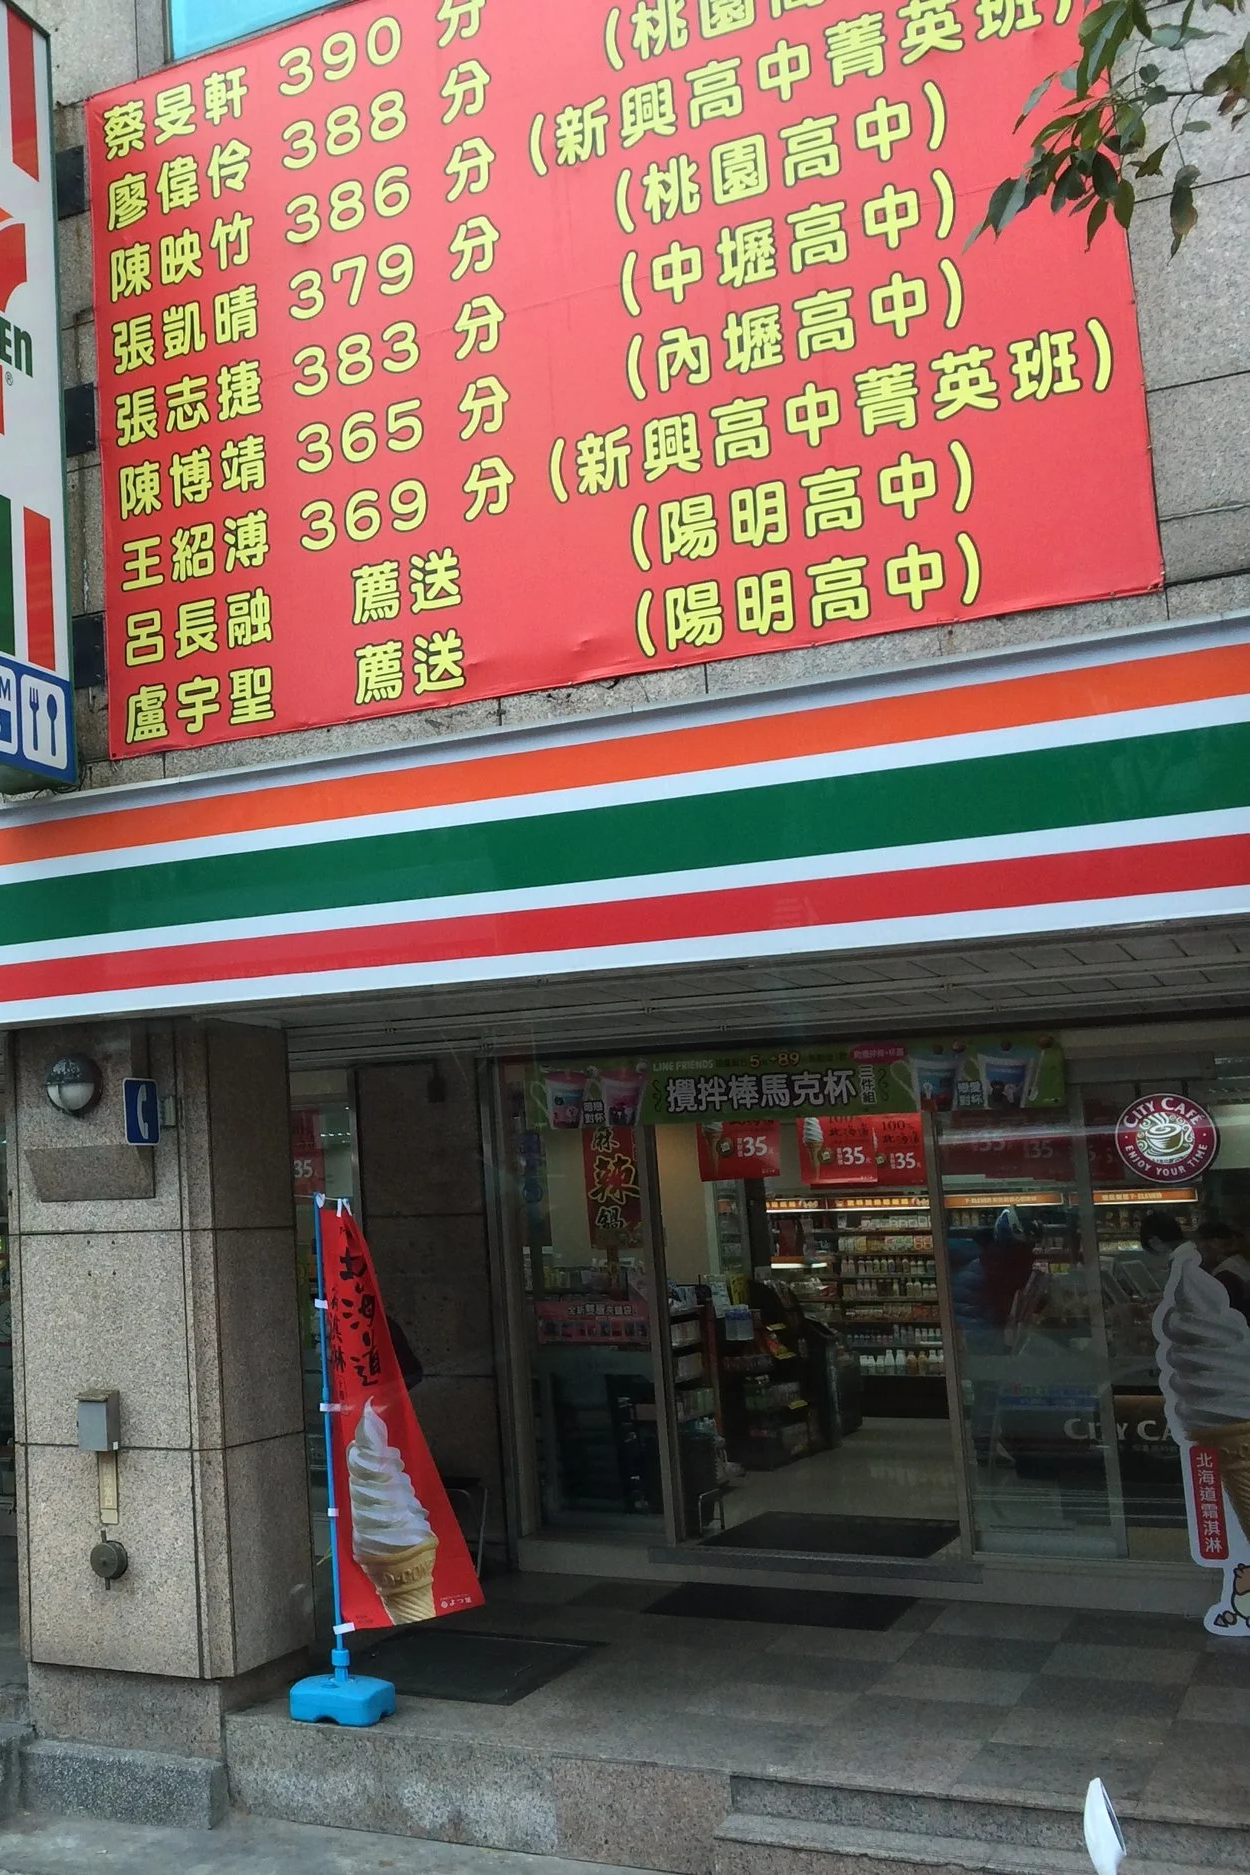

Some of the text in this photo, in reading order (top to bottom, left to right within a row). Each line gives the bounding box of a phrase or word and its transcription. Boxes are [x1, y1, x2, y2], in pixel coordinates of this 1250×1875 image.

[102, 0, 487, 160] 蔡旻軒 390 分
[107, 139, 252, 232] 廖偉伶
[282, 90, 407, 170] 388
[440, 59, 492, 126] 分
[109, 212, 254, 302] 陳映竹
[284, 165, 411, 245] 386
[445, 136, 496, 203] 分
[112, 80, 948, 375] 張凱晴 379 分 (桃園高中)
[115, 168, 956, 448] 張志捷 383 分 (中壢高中)
[119, 434, 267, 520] 陳博靖
[296, 398, 424, 474] 365
[459, 375, 510, 442] 分
[121, 317, 1113, 593] 王紹溥 369 分 (新興高中菁英班)
[125, 438, 973, 668] 呂長融 薦送 (陽明高中)
[125, 532, 982, 745] 盧宇聖 薦送 (陽明高中)
[665, 1068, 857, 1114] 攪拌棒馬克杯
[743, 1136, 768, 1157] 35
[842, 1146, 866, 1165] 35
[895, 1151, 917, 1169] 35
[1123, 1100, 1156, 1128] CITY
[1125, 1144, 1152, 1172] ENJOY
[1156, 1165, 1187, 1177] YOUR
[1187, 1143, 1208, 1167] TIME
[1196, 1452, 1223, 1554] 北海道霜淇淋
